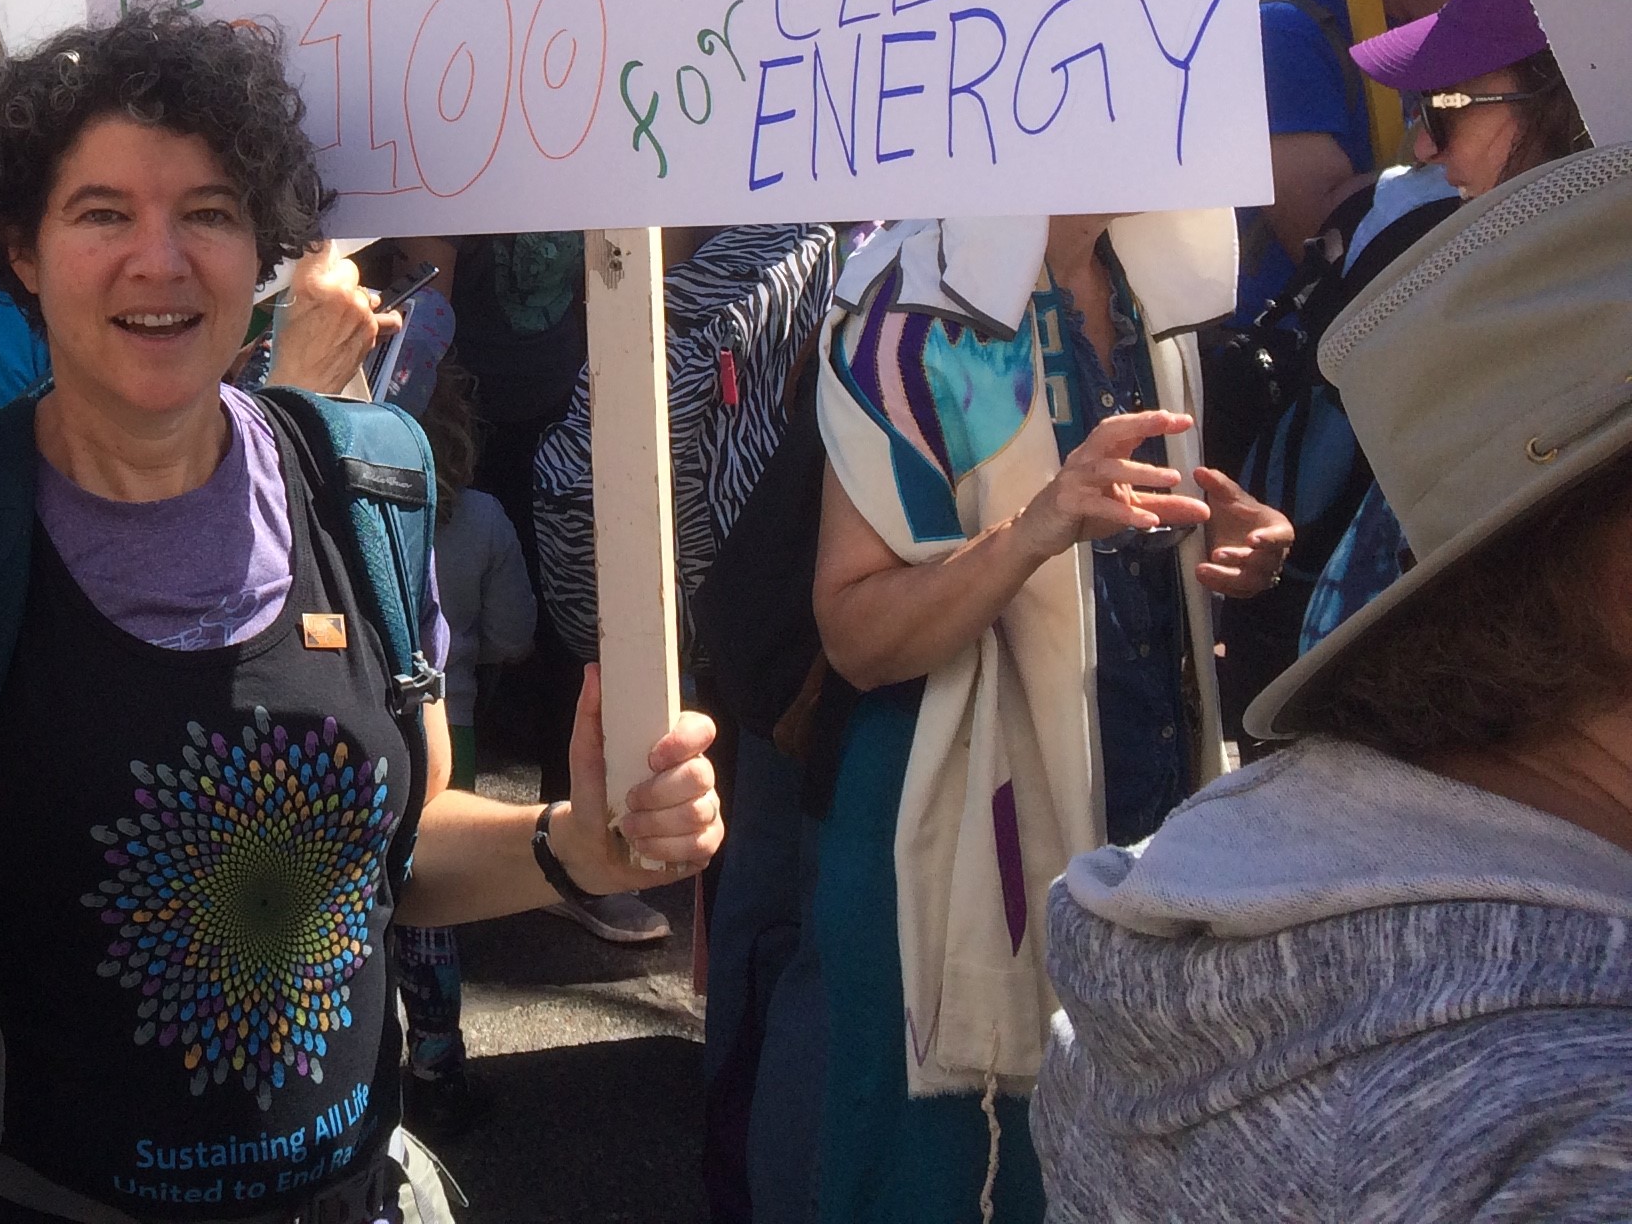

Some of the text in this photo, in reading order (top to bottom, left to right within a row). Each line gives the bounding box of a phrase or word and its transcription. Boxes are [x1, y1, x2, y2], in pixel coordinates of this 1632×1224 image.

[135, 1082, 370, 1170] Sustaining All Life
[112, 1175, 223, 1204] United
[232, 1180, 267, 1200] to
[276, 1160, 325, 1193] End
